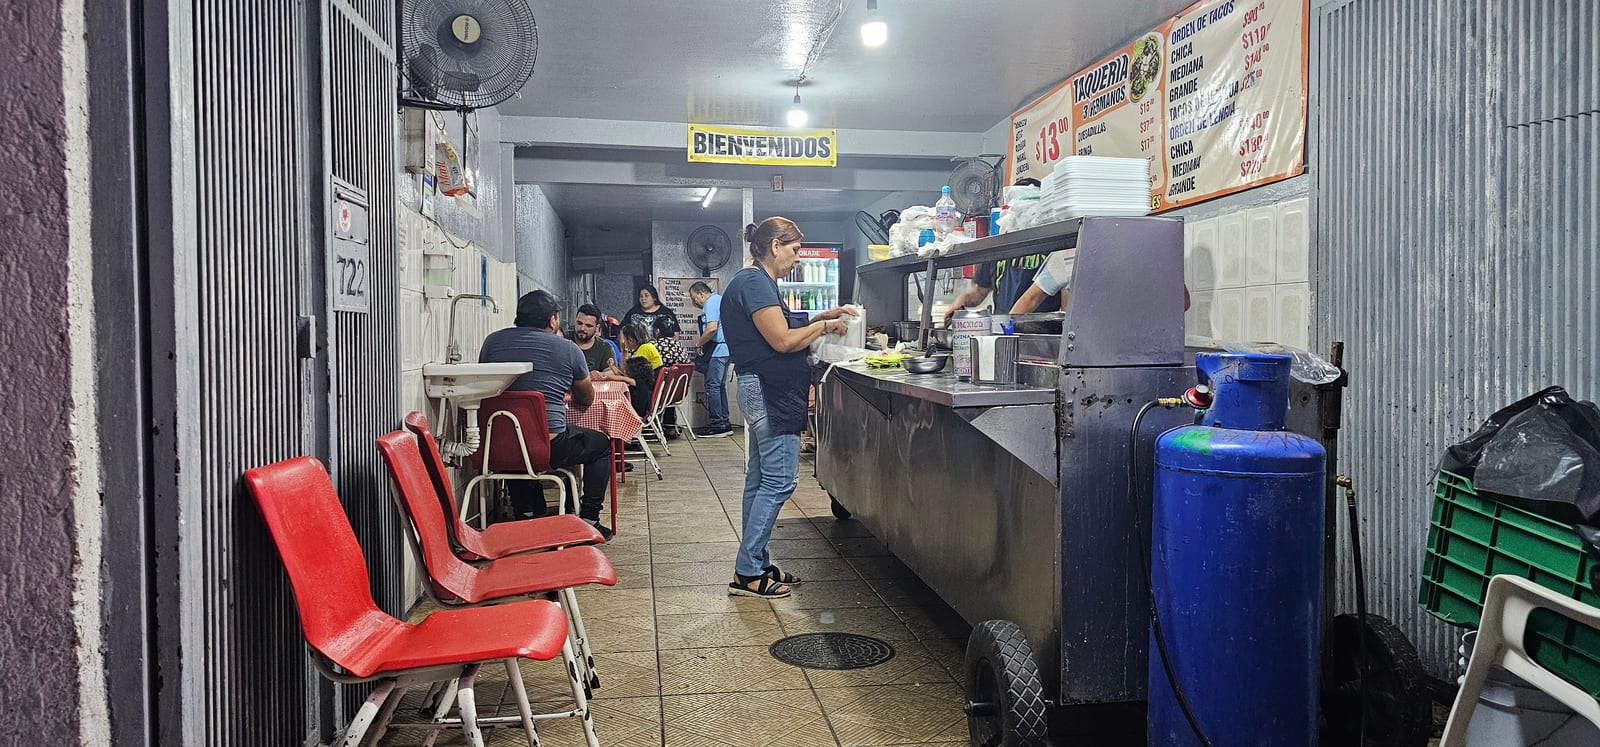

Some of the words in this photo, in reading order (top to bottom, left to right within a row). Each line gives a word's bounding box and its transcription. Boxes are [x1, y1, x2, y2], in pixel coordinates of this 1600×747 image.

[1171, 22, 1196, 45] ORDEN
[1197, 15, 1207, 31] DE
[1209, 0, 1235, 24] TACOS
[1171, 42, 1193, 64] CHICA
[1073, 54, 1129, 103] TAQUERIA
[1170, 56, 1204, 83] MEDIANA
[1170, 78, 1198, 102] GRANDE
[1083, 105, 1089, 119] 3
[1170, 101, 1193, 121] TACOS
[1078, 122, 1107, 143] QUESADILLAS
[1170, 119, 1195, 141] ORDEN
[1197, 114, 1208, 131] DE
[694, 132, 831, 159] BIENVENIDOS
[1170, 140, 1194, 159] CHICA
[1172, 155, 1202, 178] MEDIANA
[1169, 176, 1196, 196] GRANDE
[337, 255, 365, 296] 722
